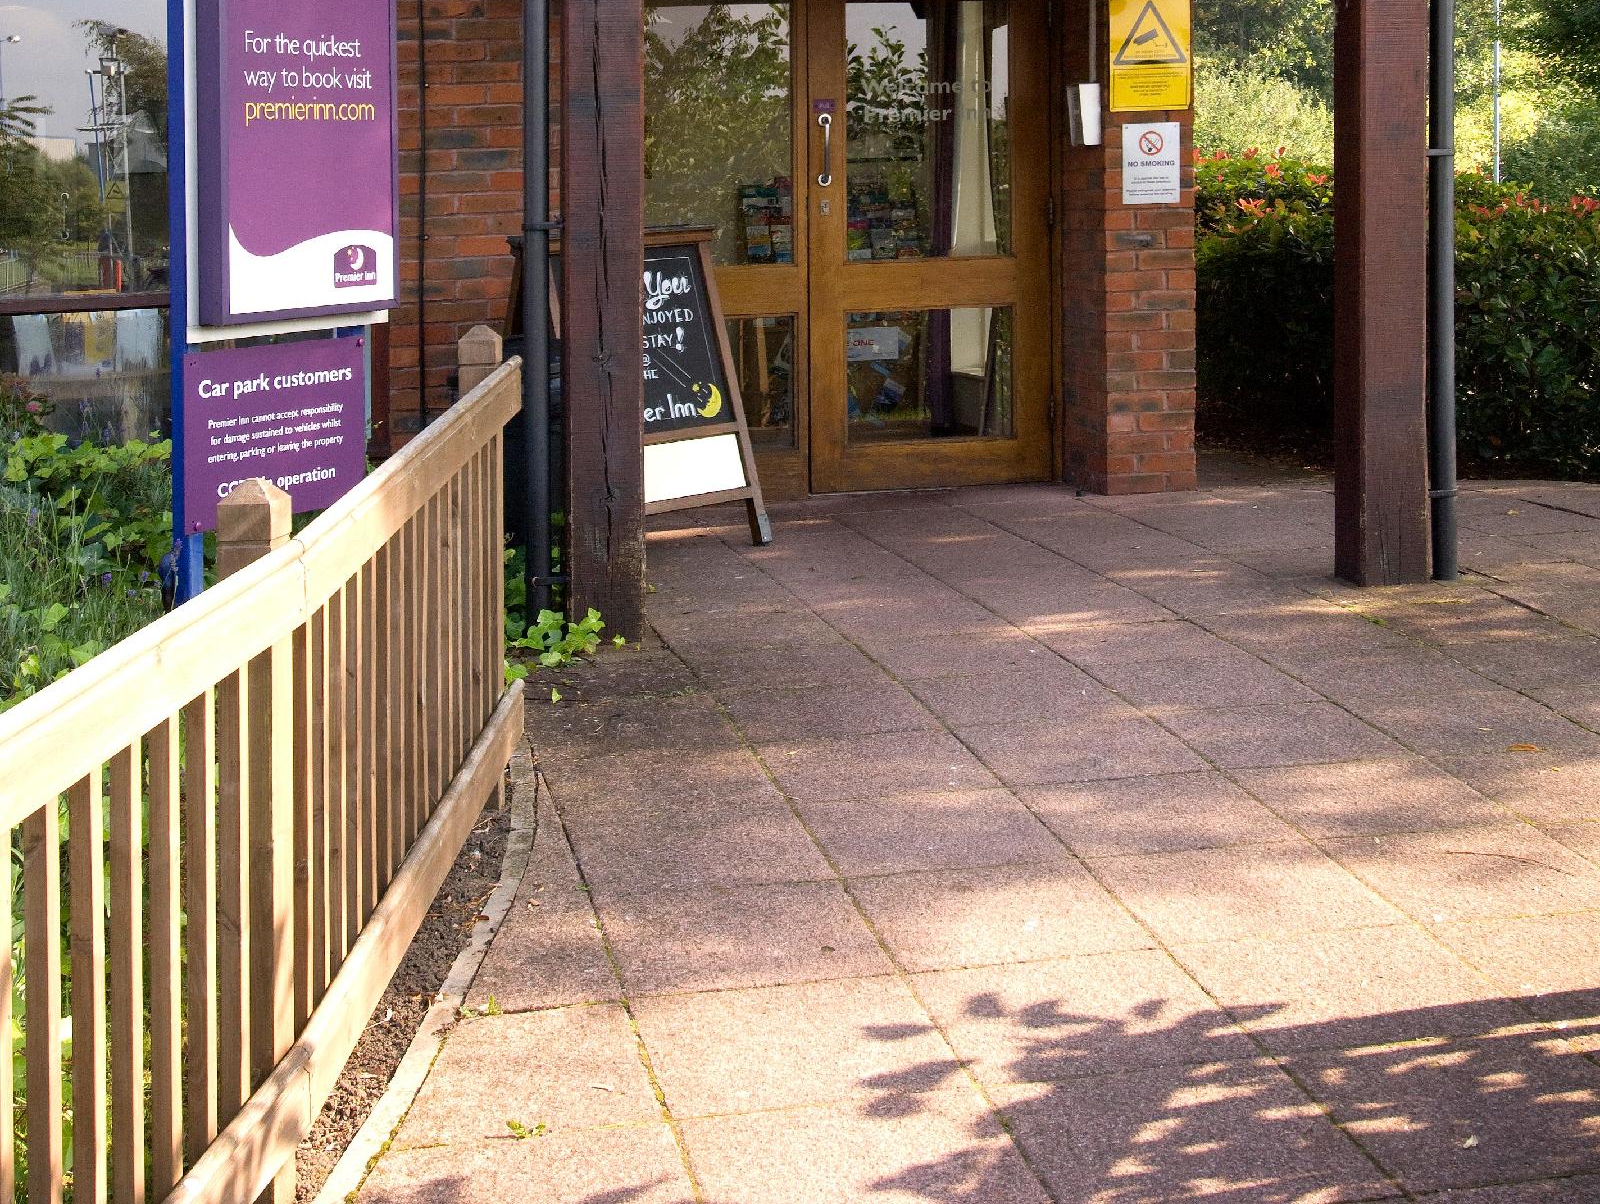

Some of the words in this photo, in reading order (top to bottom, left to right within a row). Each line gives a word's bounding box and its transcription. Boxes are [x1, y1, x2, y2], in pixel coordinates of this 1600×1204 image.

[244, 30, 271, 53] For
[274, 32, 300, 55] the
[303, 34, 361, 62] quickest
[243, 70, 277, 94] way
[281, 67, 299, 87] to
[302, 65, 343, 89] book
[345, 67, 372, 90] visit
[861, 78, 963, 94] Welcome
[244, 95, 375, 127] premierinn.com
[863, 107, 952, 123] Premier
[335, 272, 363, 283] Premier
[364, 271, 376, 281] Inn
[644, 271, 691, 310] You
[643, 308, 694, 326] NJOYED
[198, 379, 230, 399] Car
[233, 372, 270, 400] park
[273, 367, 352, 390] customers
[643, 369, 660, 380] HE
[208, 417, 238, 430] Premier
[239, 415, 250, 426] Inn
[251, 412, 275, 424] cannot
[276, 409, 299, 420] accept
[301, 402, 344, 417] responsibility
[643, 407, 665, 422] er
[666, 393, 698, 418] Inn
[210, 435, 222, 446] for
[223, 434, 250, 444] damage
[251, 425, 284, 440] sustained
[284, 426, 294, 435] to
[294, 421, 321, 433] vehicles
[321, 417, 342, 428] whilst
[240, 446, 266, 461] parking
[266, 445, 276, 453] or
[277, 441, 300, 453] leaving
[301, 438, 313, 449] the
[314, 435, 344, 449] property
[276, 467, 336, 491] operation
